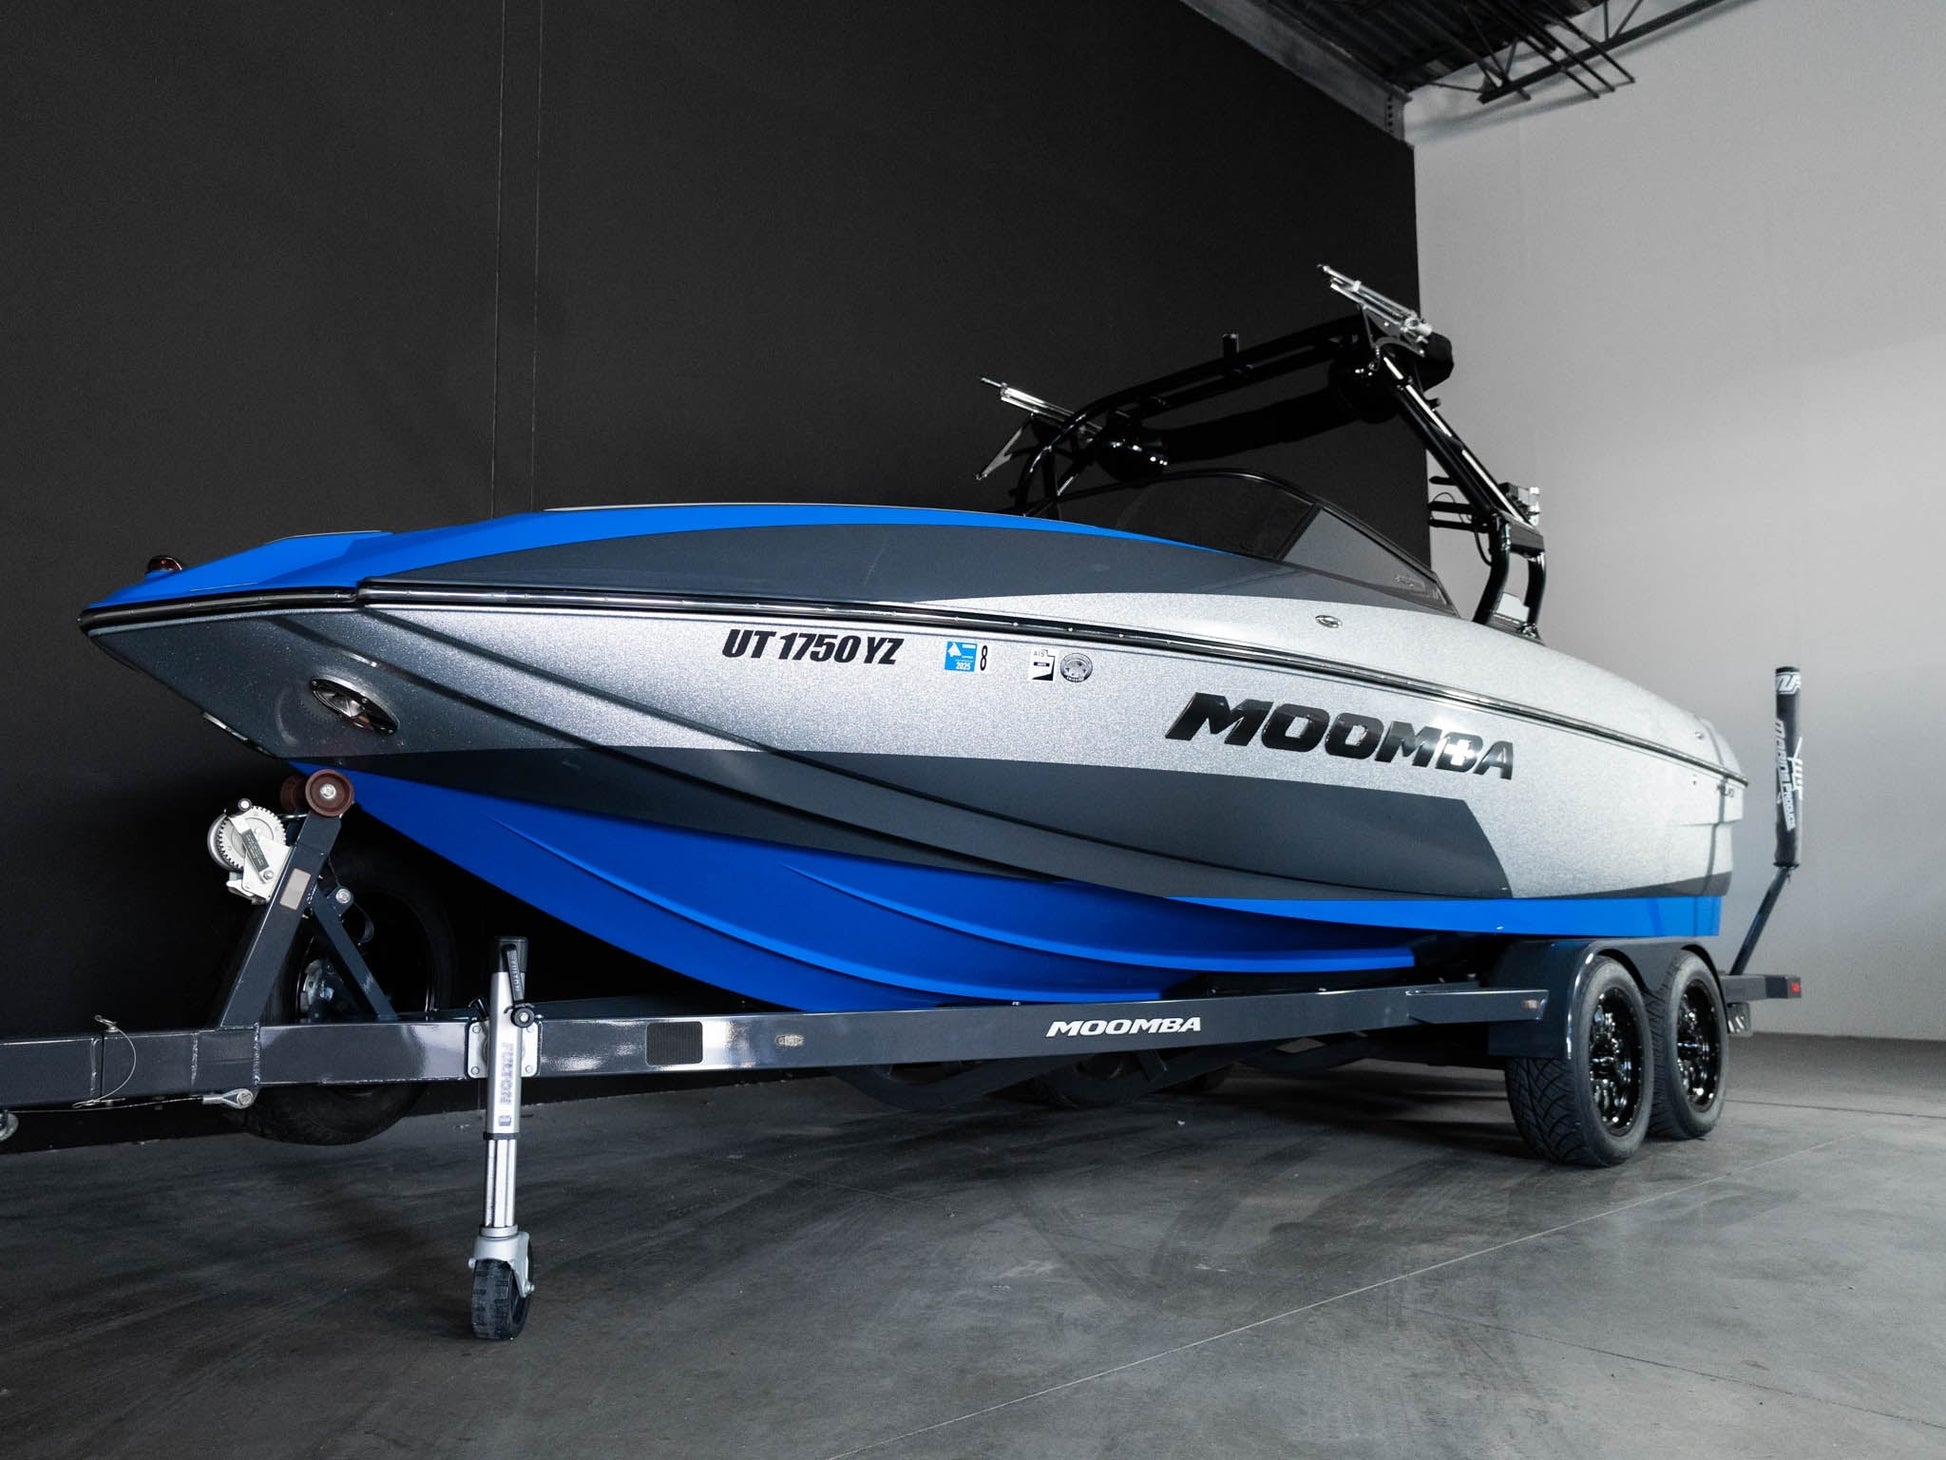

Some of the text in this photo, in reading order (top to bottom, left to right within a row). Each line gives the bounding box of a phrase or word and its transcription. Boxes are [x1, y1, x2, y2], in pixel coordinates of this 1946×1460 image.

[722, 629, 905, 665] UT 1750 YZ
[980, 645, 988, 671] 8
[955, 661, 971, 670] 2025
[1165, 692, 1514, 780] MOOMBA
[1046, 1016, 1201, 1038] MOOMBA
